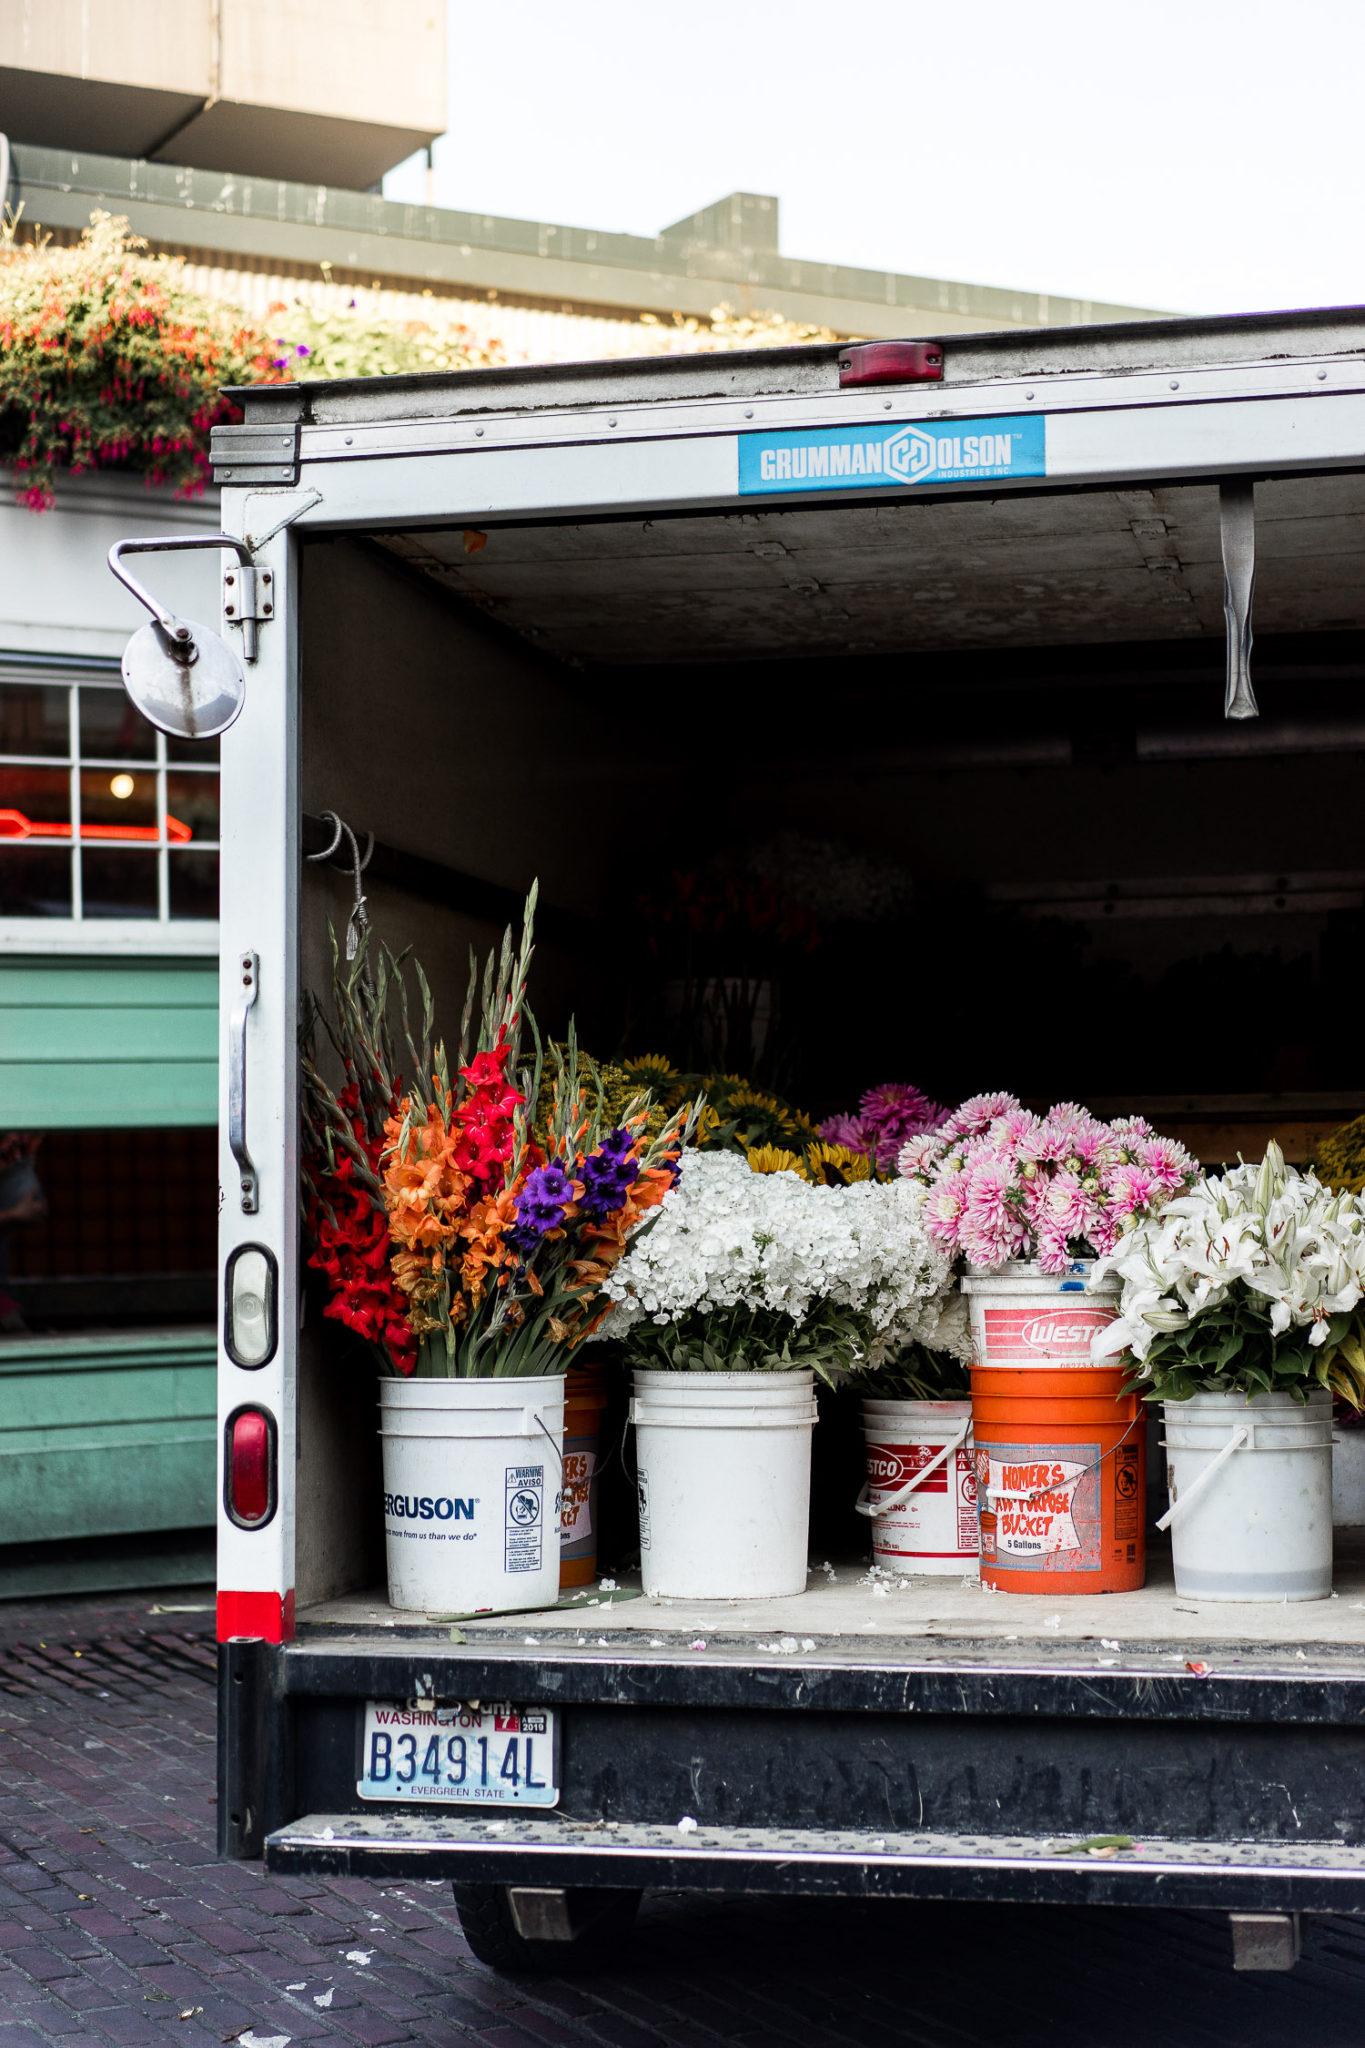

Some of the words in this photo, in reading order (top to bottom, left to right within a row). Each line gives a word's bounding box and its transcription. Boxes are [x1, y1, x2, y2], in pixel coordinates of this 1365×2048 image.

[760, 442, 883, 480] GRUMMAN
[937, 434, 1012, 469] OLSON
[937, 467, 990, 478] INDUSTRIES
[993, 466, 1012, 475] INC.
[518, 1478, 541, 1486] AVISO
[1002, 1464, 1065, 1490] HOMER'S
[1001, 1513, 1053, 1536] BUCKET
[404, 1530, 418, 1539] from
[1007, 1540, 1012, 1548] 5
[1013, 1540, 1041, 1549] Gallons
[370, 1732, 546, 1788] B34914L
[411, 1786, 470, 1796] EVERGREEN
[474, 1789, 505, 1798] STATE
